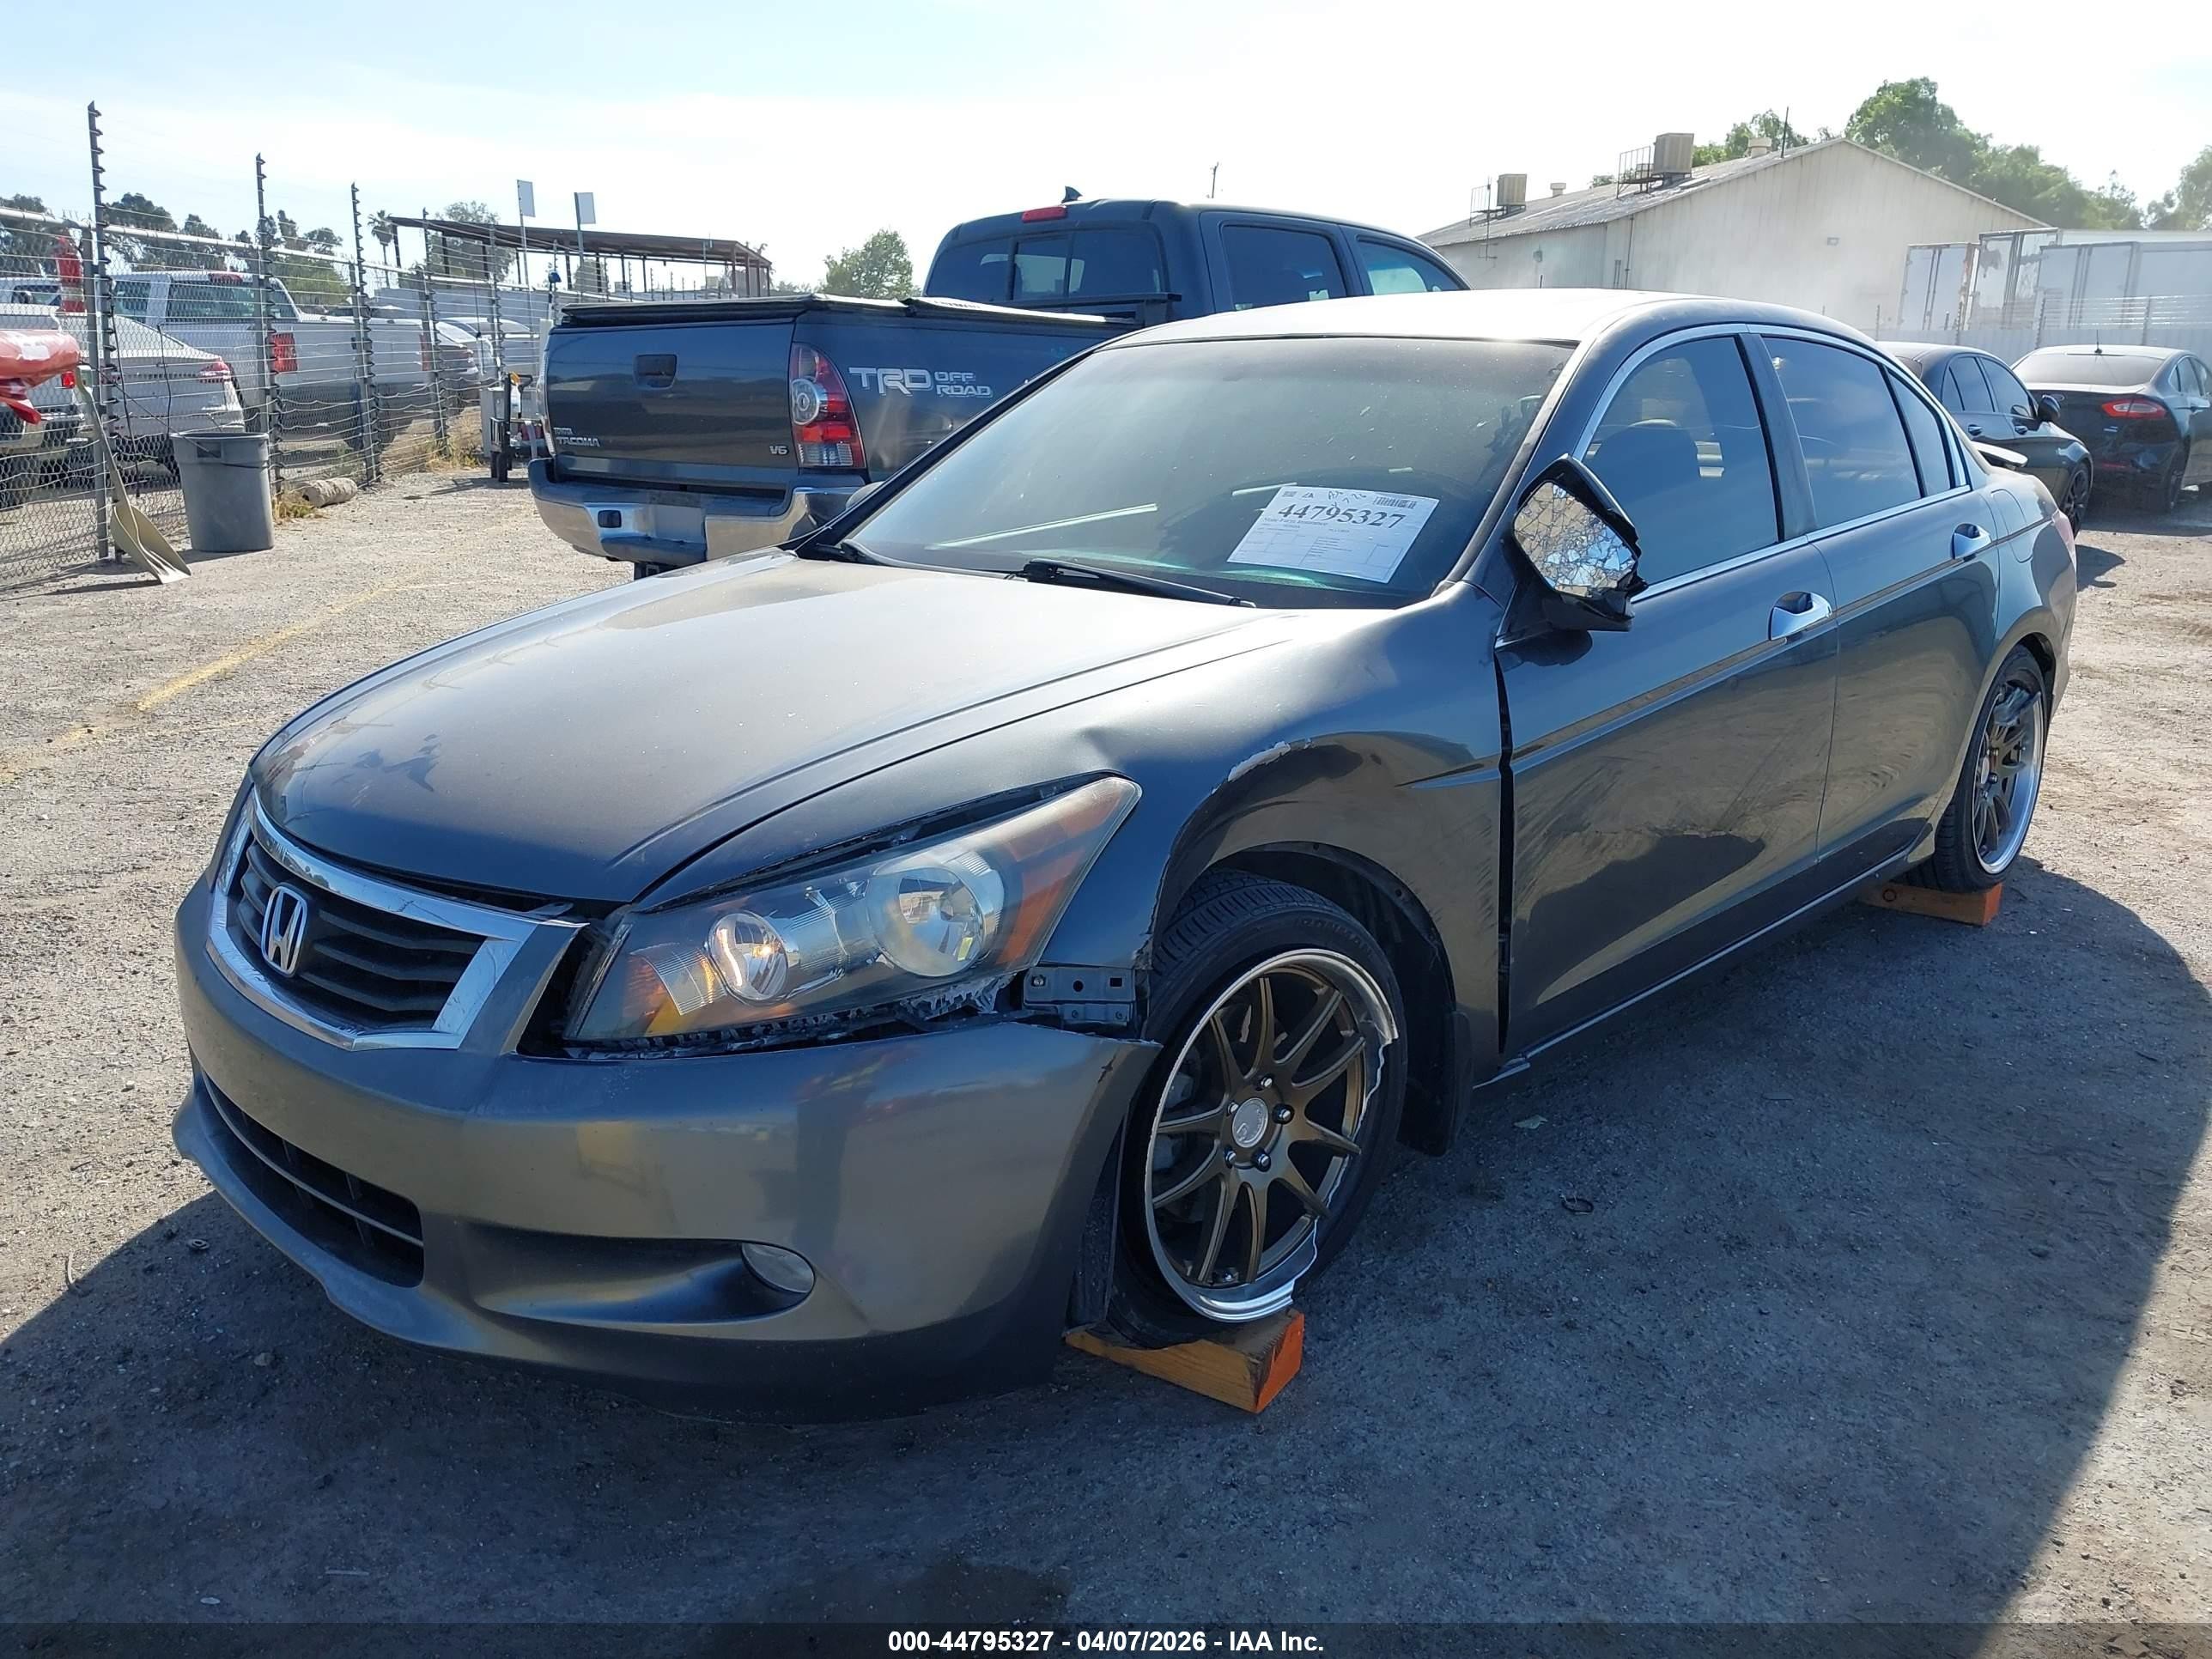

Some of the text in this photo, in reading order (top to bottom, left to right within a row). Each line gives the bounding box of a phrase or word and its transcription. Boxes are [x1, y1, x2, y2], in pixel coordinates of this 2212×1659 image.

[848, 367, 932, 396] TRD
[934, 371, 975, 383] OFF
[936, 385, 993, 398] ROAD
[556, 436, 601, 447] TACOMA
[769, 445, 788, 455] V6
[1278, 503, 1407, 529] 44795327
